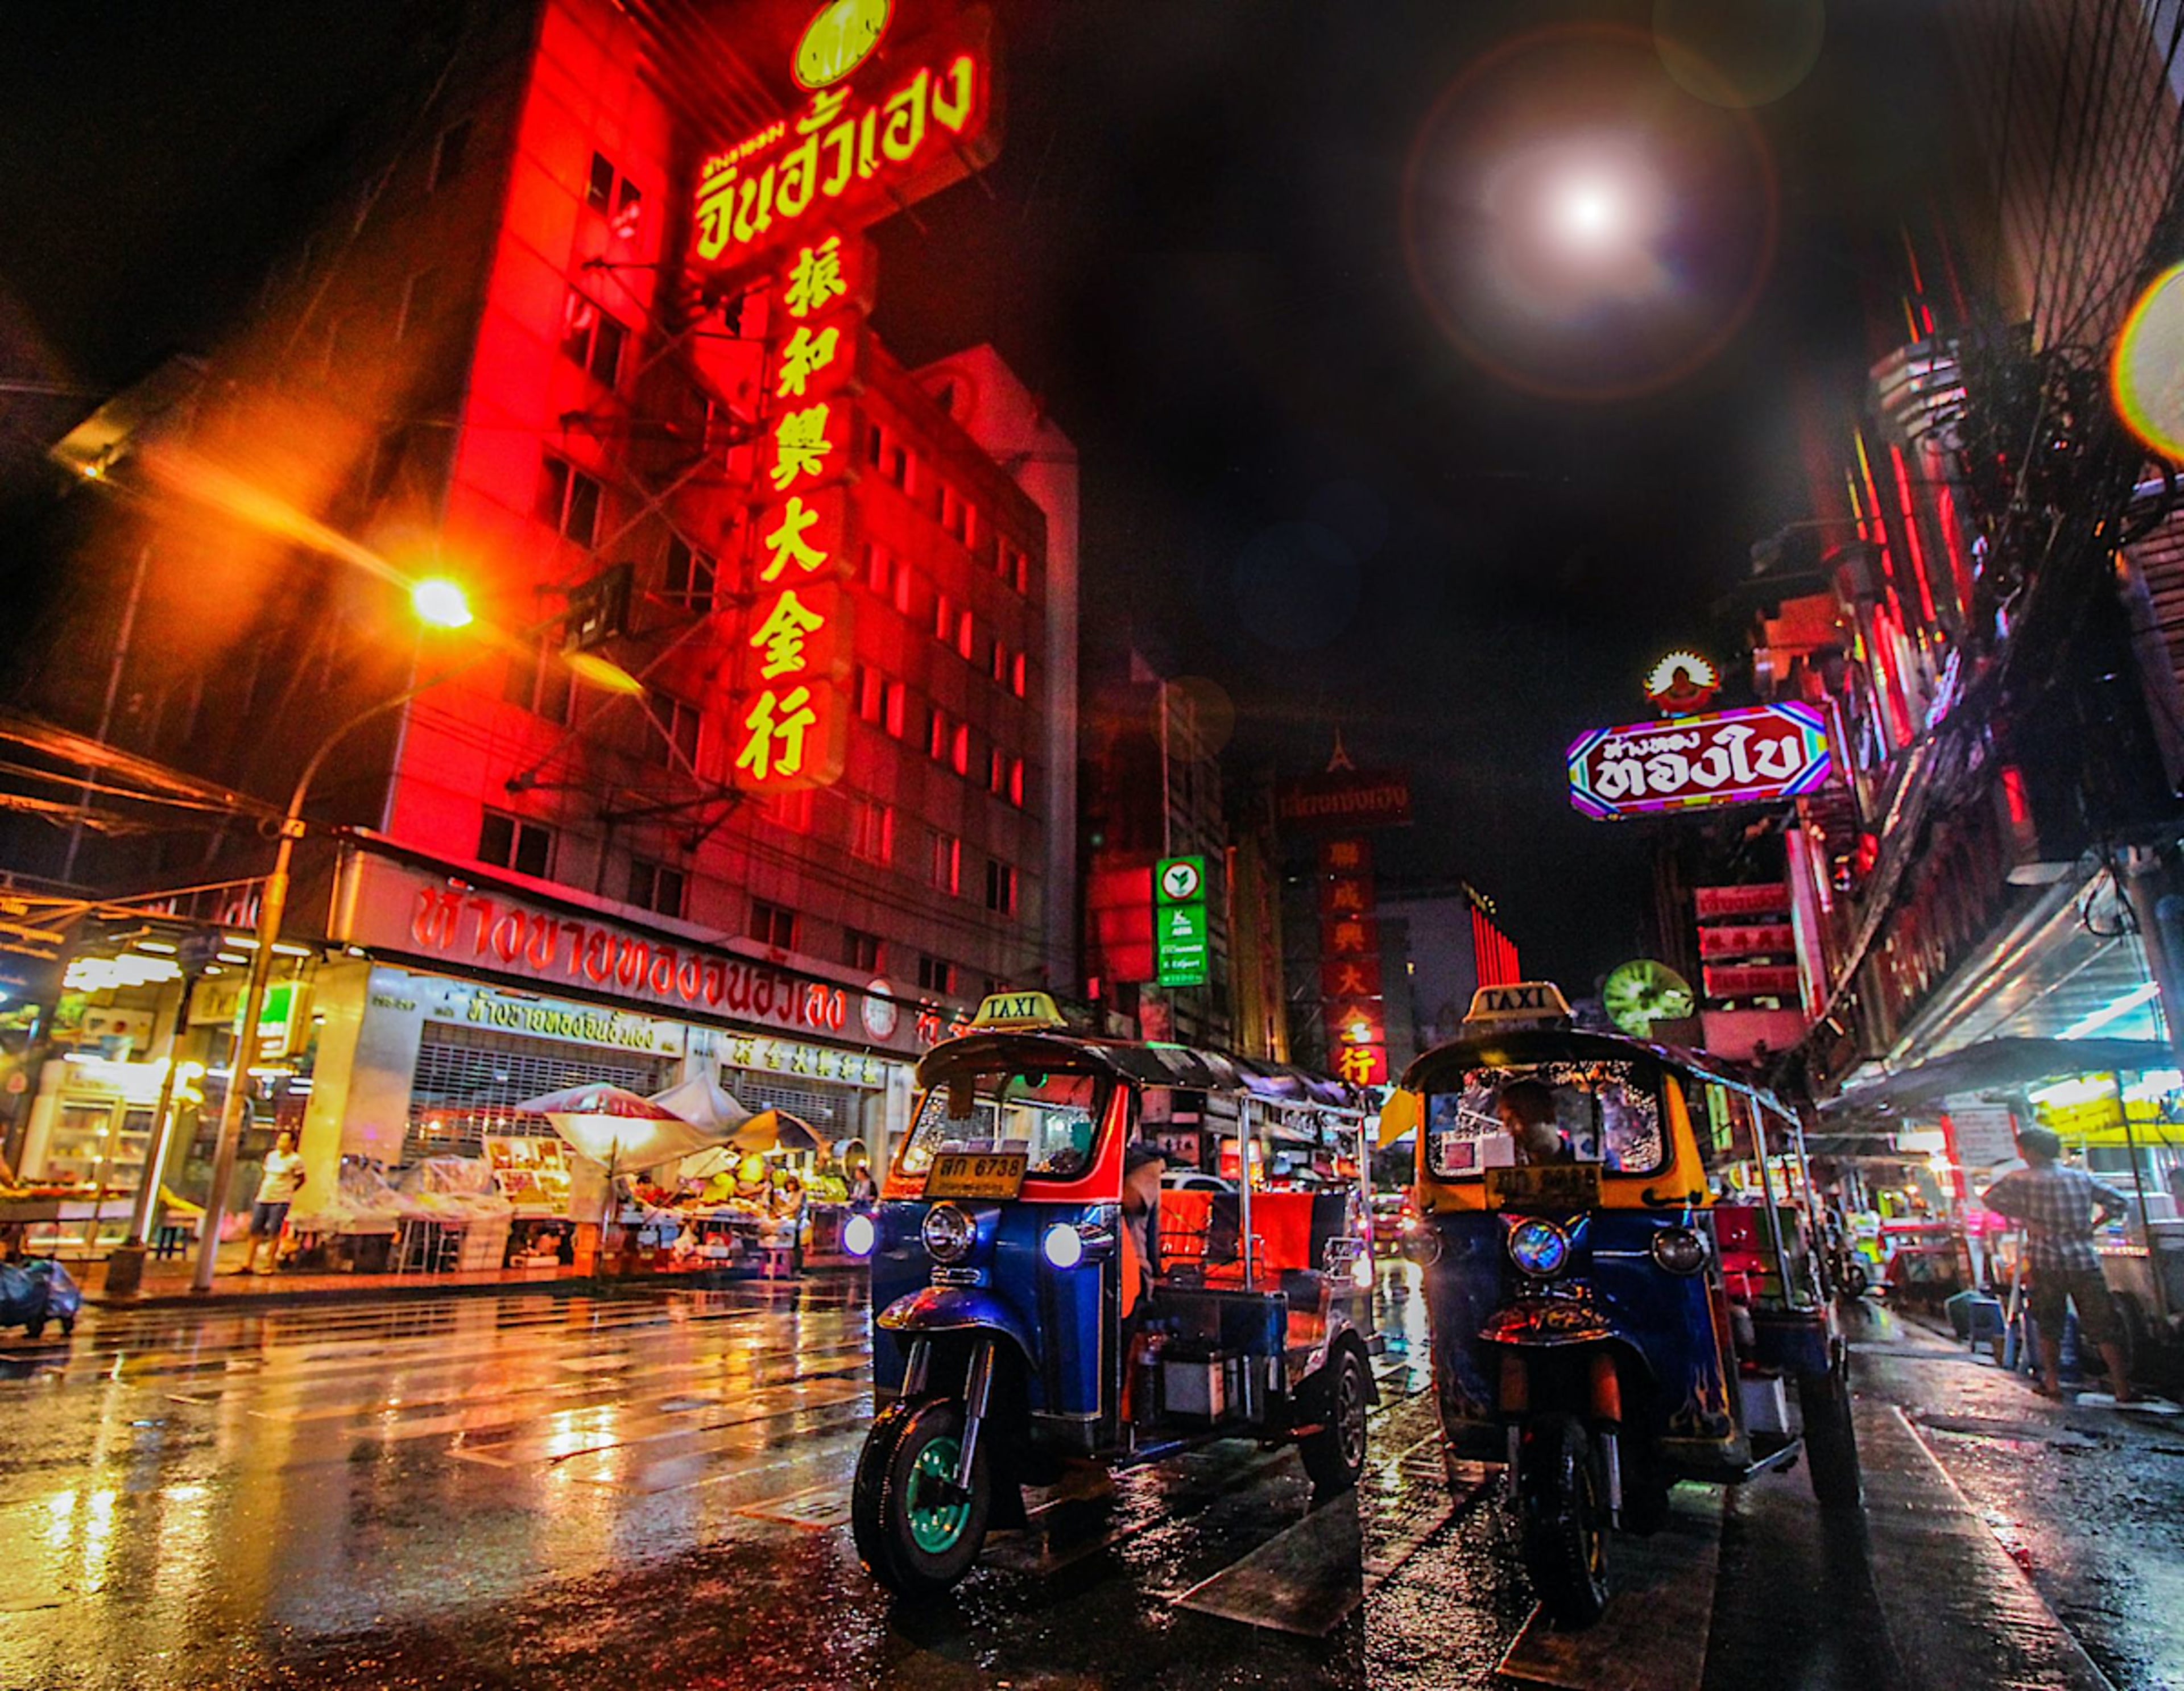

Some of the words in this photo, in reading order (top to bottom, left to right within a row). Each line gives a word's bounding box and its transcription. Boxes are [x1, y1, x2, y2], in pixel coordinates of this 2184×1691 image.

[736, 236, 846, 780] 振和興大金行
[988, 997, 1036, 1018] TAXI
[1481, 988, 1546, 1011] TAXI
[975, 1159, 1020, 1177] 6738
